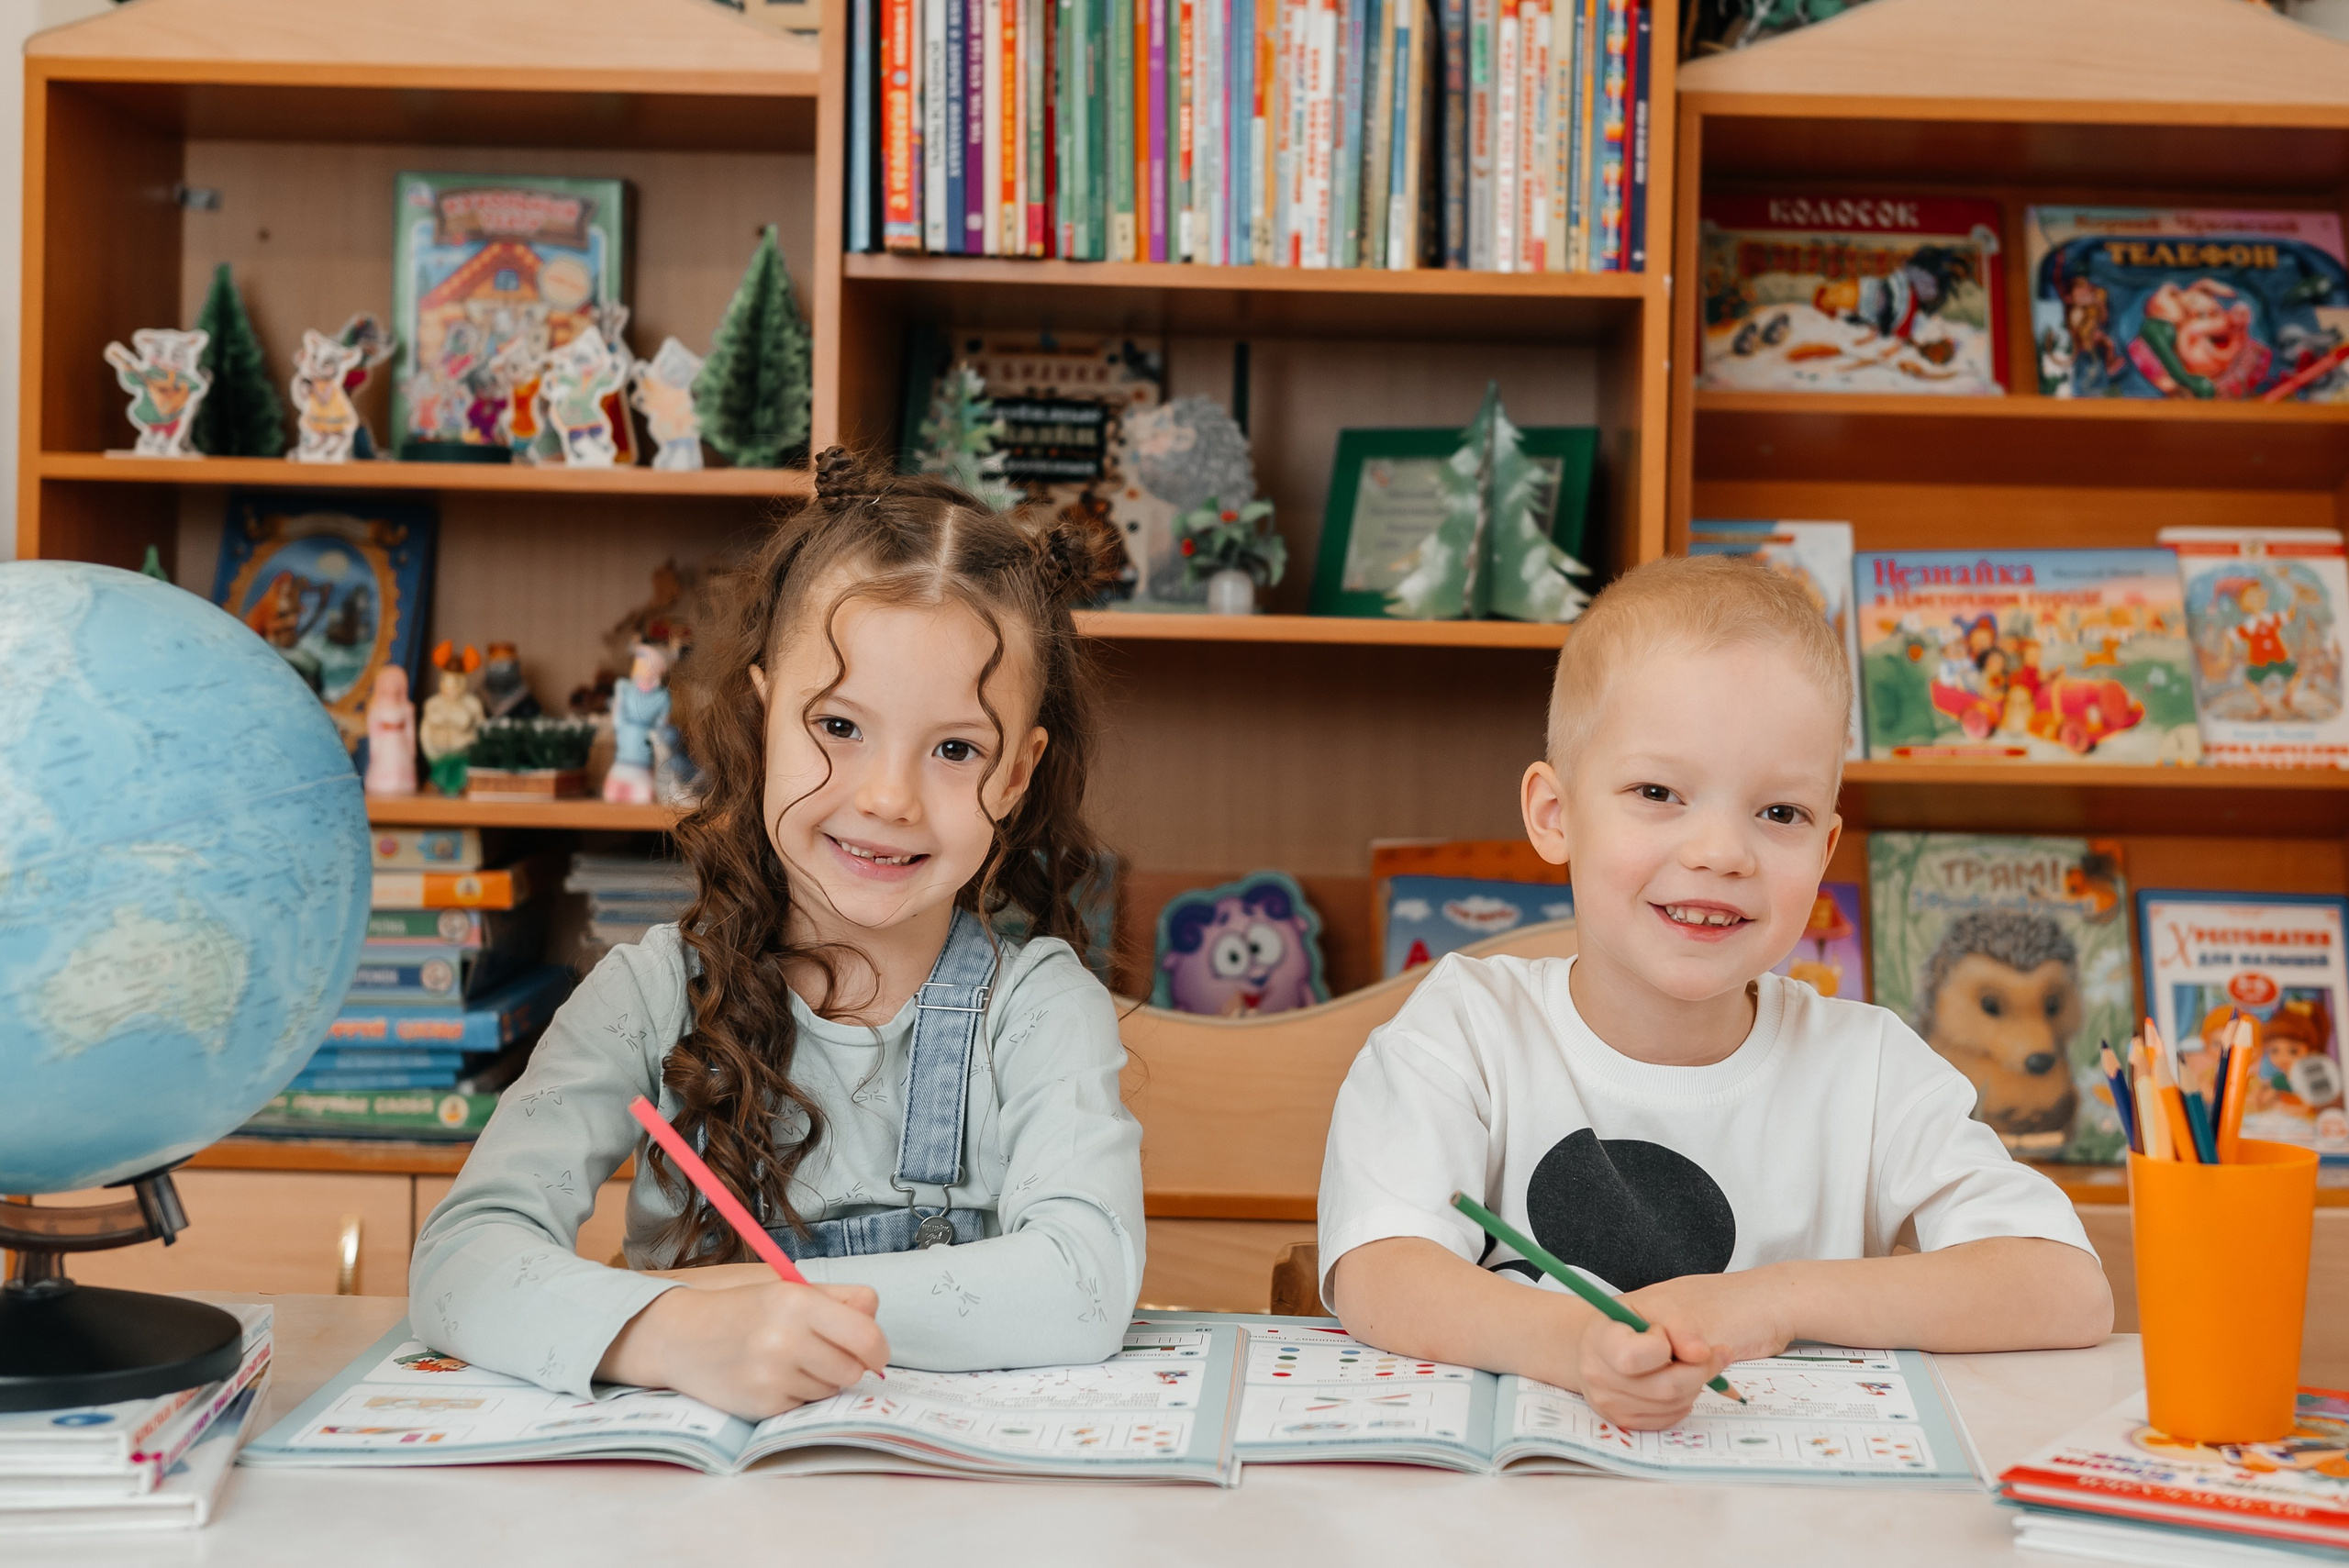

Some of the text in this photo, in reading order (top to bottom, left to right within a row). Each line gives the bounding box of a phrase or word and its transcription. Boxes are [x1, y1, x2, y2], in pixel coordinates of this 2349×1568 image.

[1768, 198, 1921, 228] КОЛОСОК
[2103, 241, 2278, 269] ТЕЛЕФОН
[1873, 558, 2036, 590] Незнайка
[1941, 857, 2061, 892] ТРЯМ!
